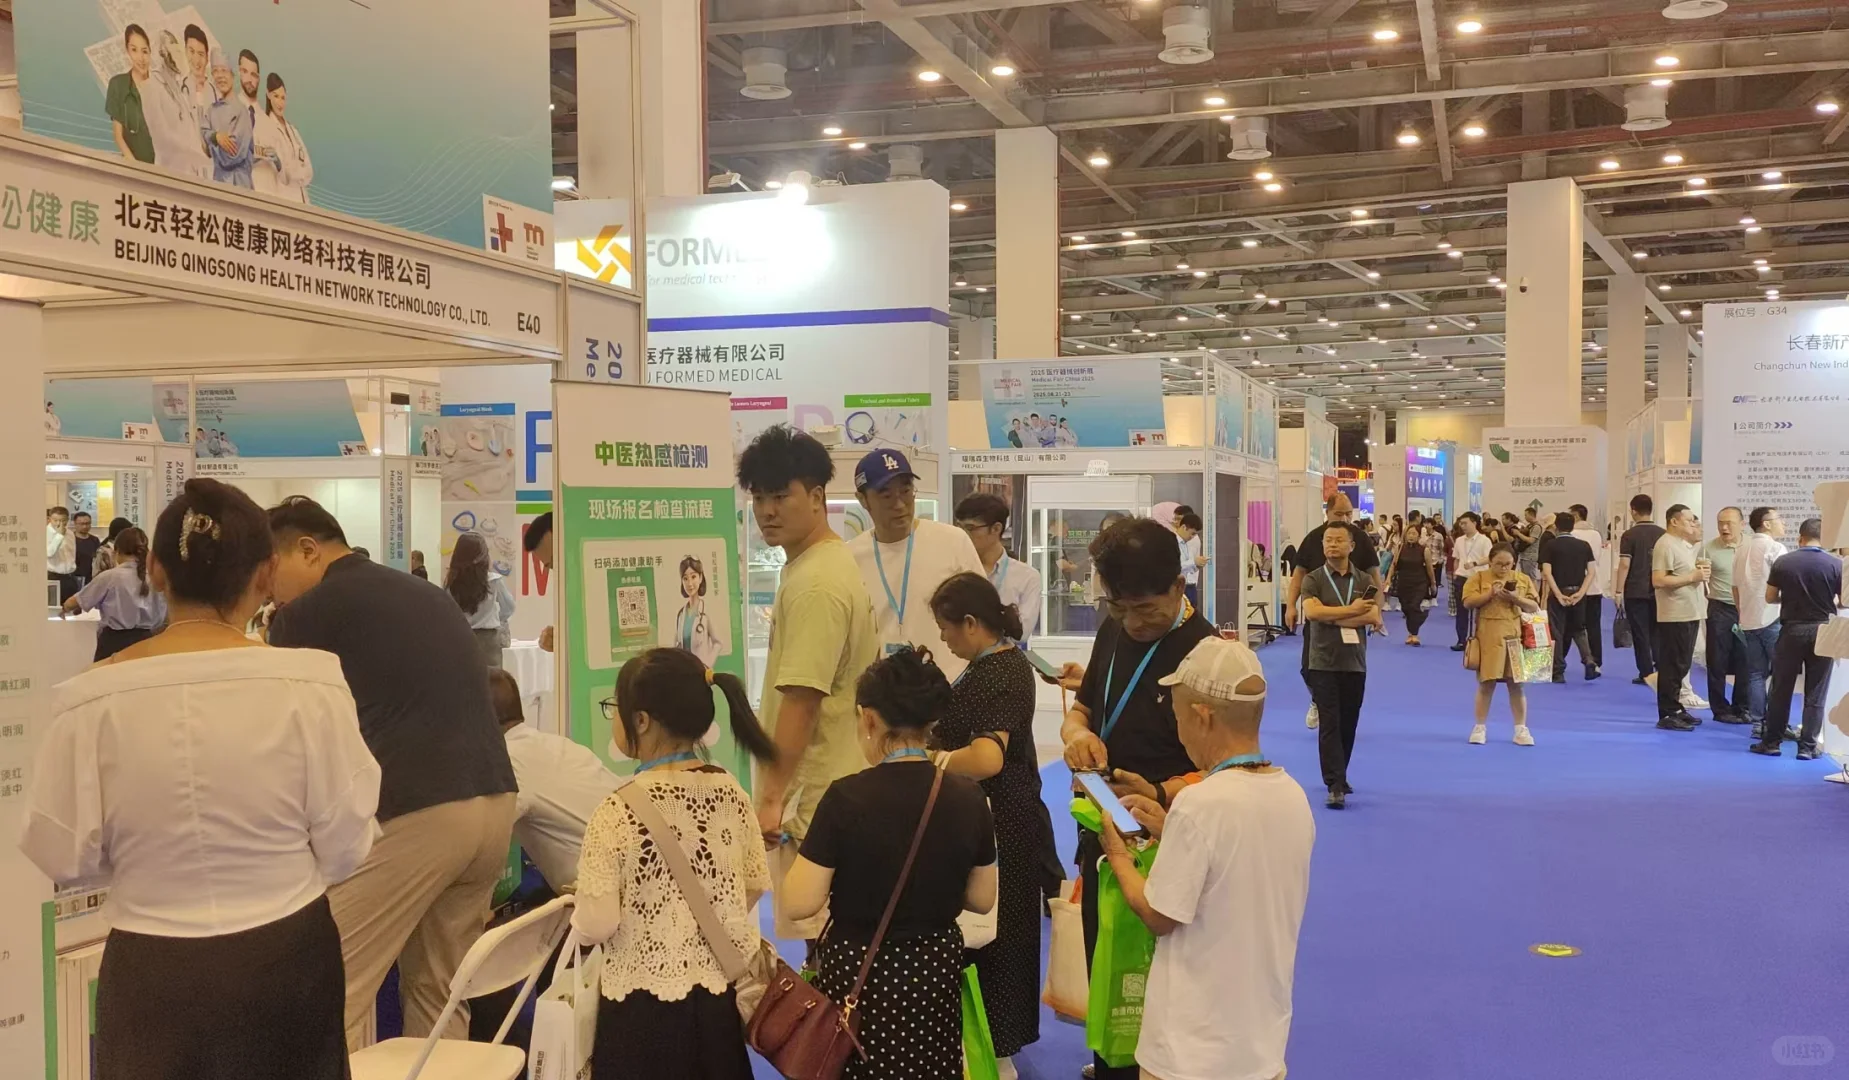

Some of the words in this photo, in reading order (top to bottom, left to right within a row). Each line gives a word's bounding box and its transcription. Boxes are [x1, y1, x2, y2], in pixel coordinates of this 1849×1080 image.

[114, 193, 432, 290] 北京轻松健康网络科技有限公司
[115, 239, 177, 269] BEIJING
[181, 252, 256, 284] QINGSONG
[260, 268, 312, 294] HEALTH
[315, 278, 375, 306] NETWORK
[377, 290, 448, 320] TECHNOLOGY
[449, 304, 469, 326] CO.,
[469, 308, 492, 328] LTD.
[663, 273, 706, 286] medical
[1766, 306, 1788, 316] G34
[517, 311, 542, 336] E40
[585, 337, 600, 382] Me
[607, 340, 623, 384] 20
[647, 343, 785, 366] 医疗器械有限公司
[655, 369, 715, 384] FORMED
[719, 367, 783, 382] MEDICAL
[1030, 369, 1045, 377] 2025
[1754, 361, 1807, 373] Changchun
[1809, 361, 1831, 370] New
[1739, 421, 1773, 431] 公司简介
[594, 440, 709, 469] 中医热感检测
[882, 453, 899, 470] LA
[131, 473, 139, 494] 2025
[176, 460, 184, 488] 2025
[1511, 476, 1565, 487] 请继续参观
[588, 499, 715, 520] 现场报名检查流程
[593, 556, 663, 569] 扫码添加健康助手
